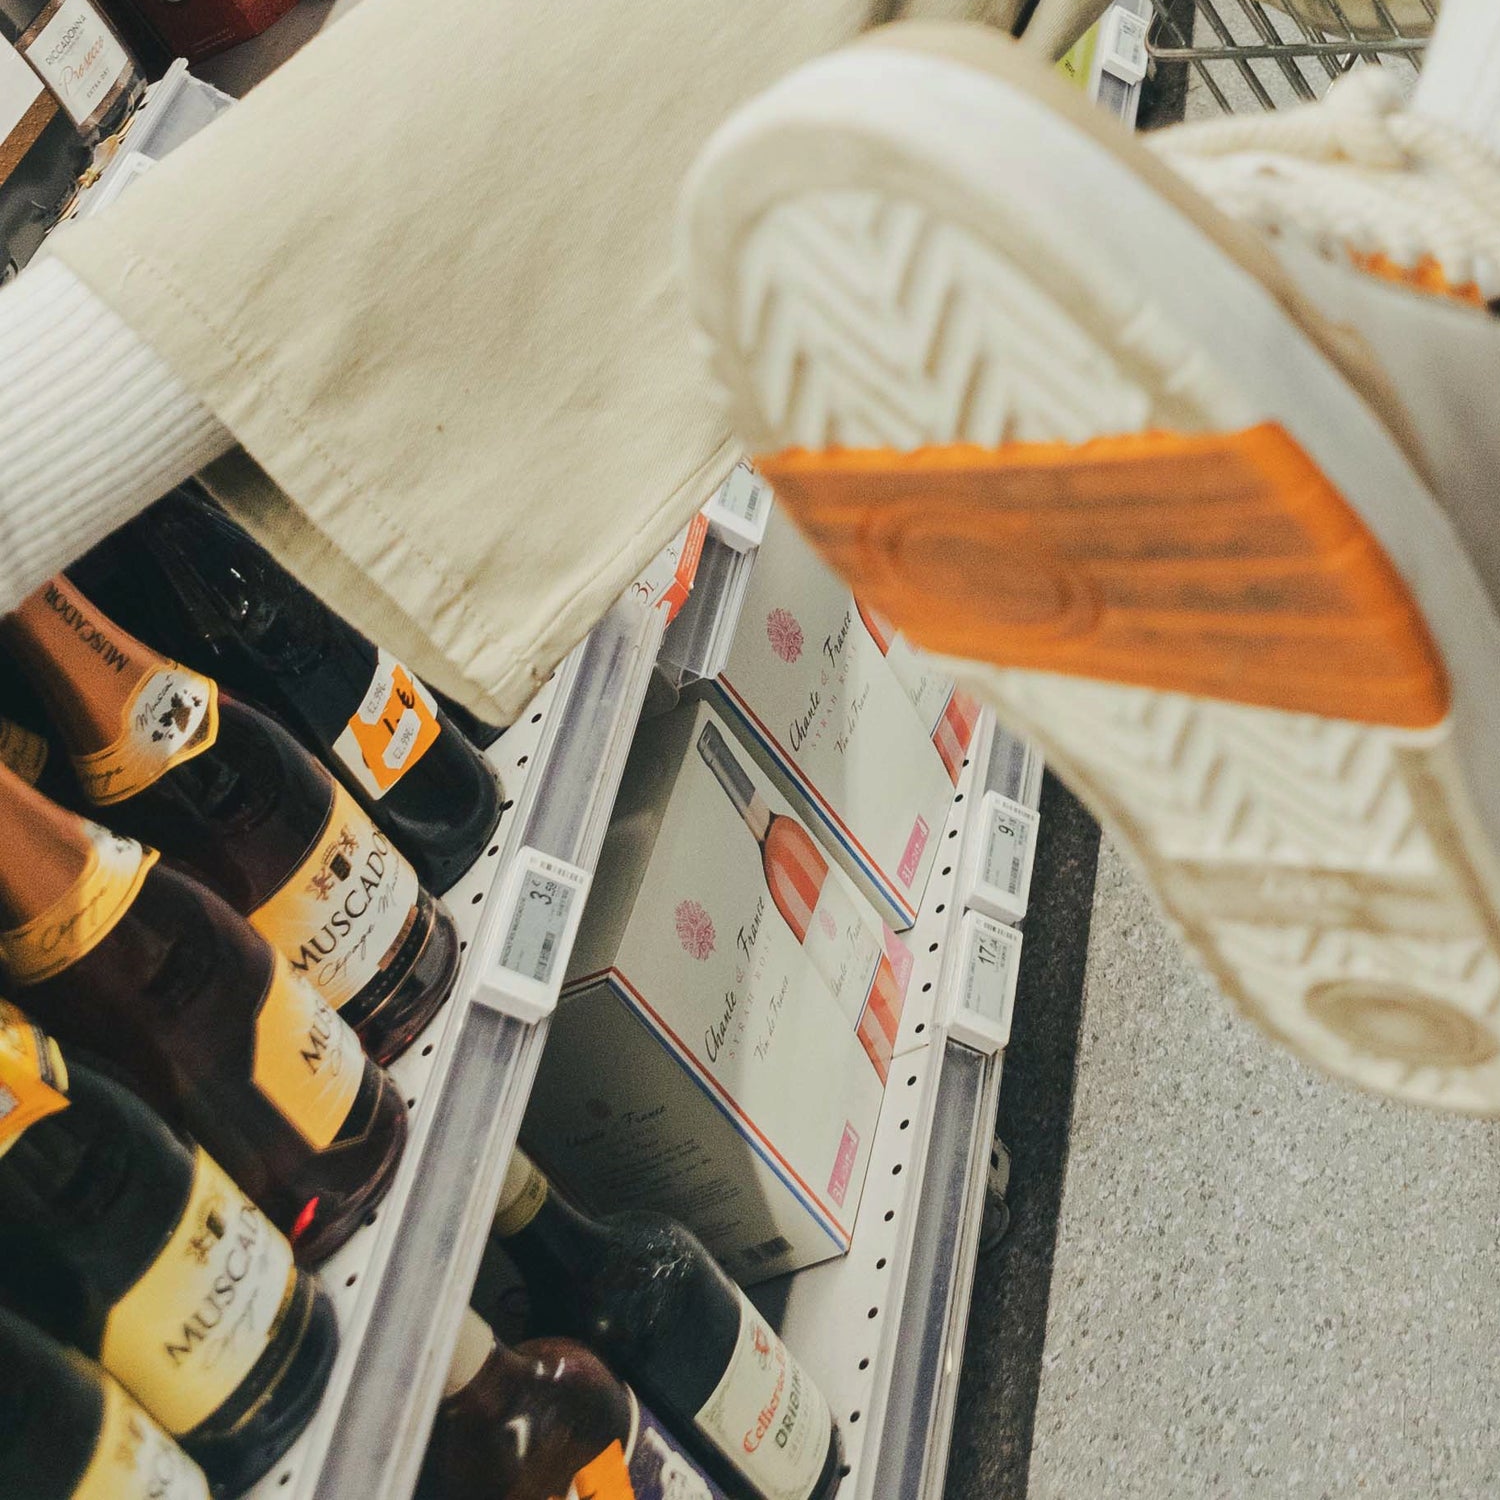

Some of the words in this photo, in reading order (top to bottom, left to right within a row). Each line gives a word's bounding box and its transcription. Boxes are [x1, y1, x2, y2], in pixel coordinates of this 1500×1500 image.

[44, 12, 89, 67] RICCADONNA
[789, 689, 821, 752] Chante
[823, 610, 852, 674] France
[704, 990, 737, 1064] Chante
[737, 895, 766, 960] France
